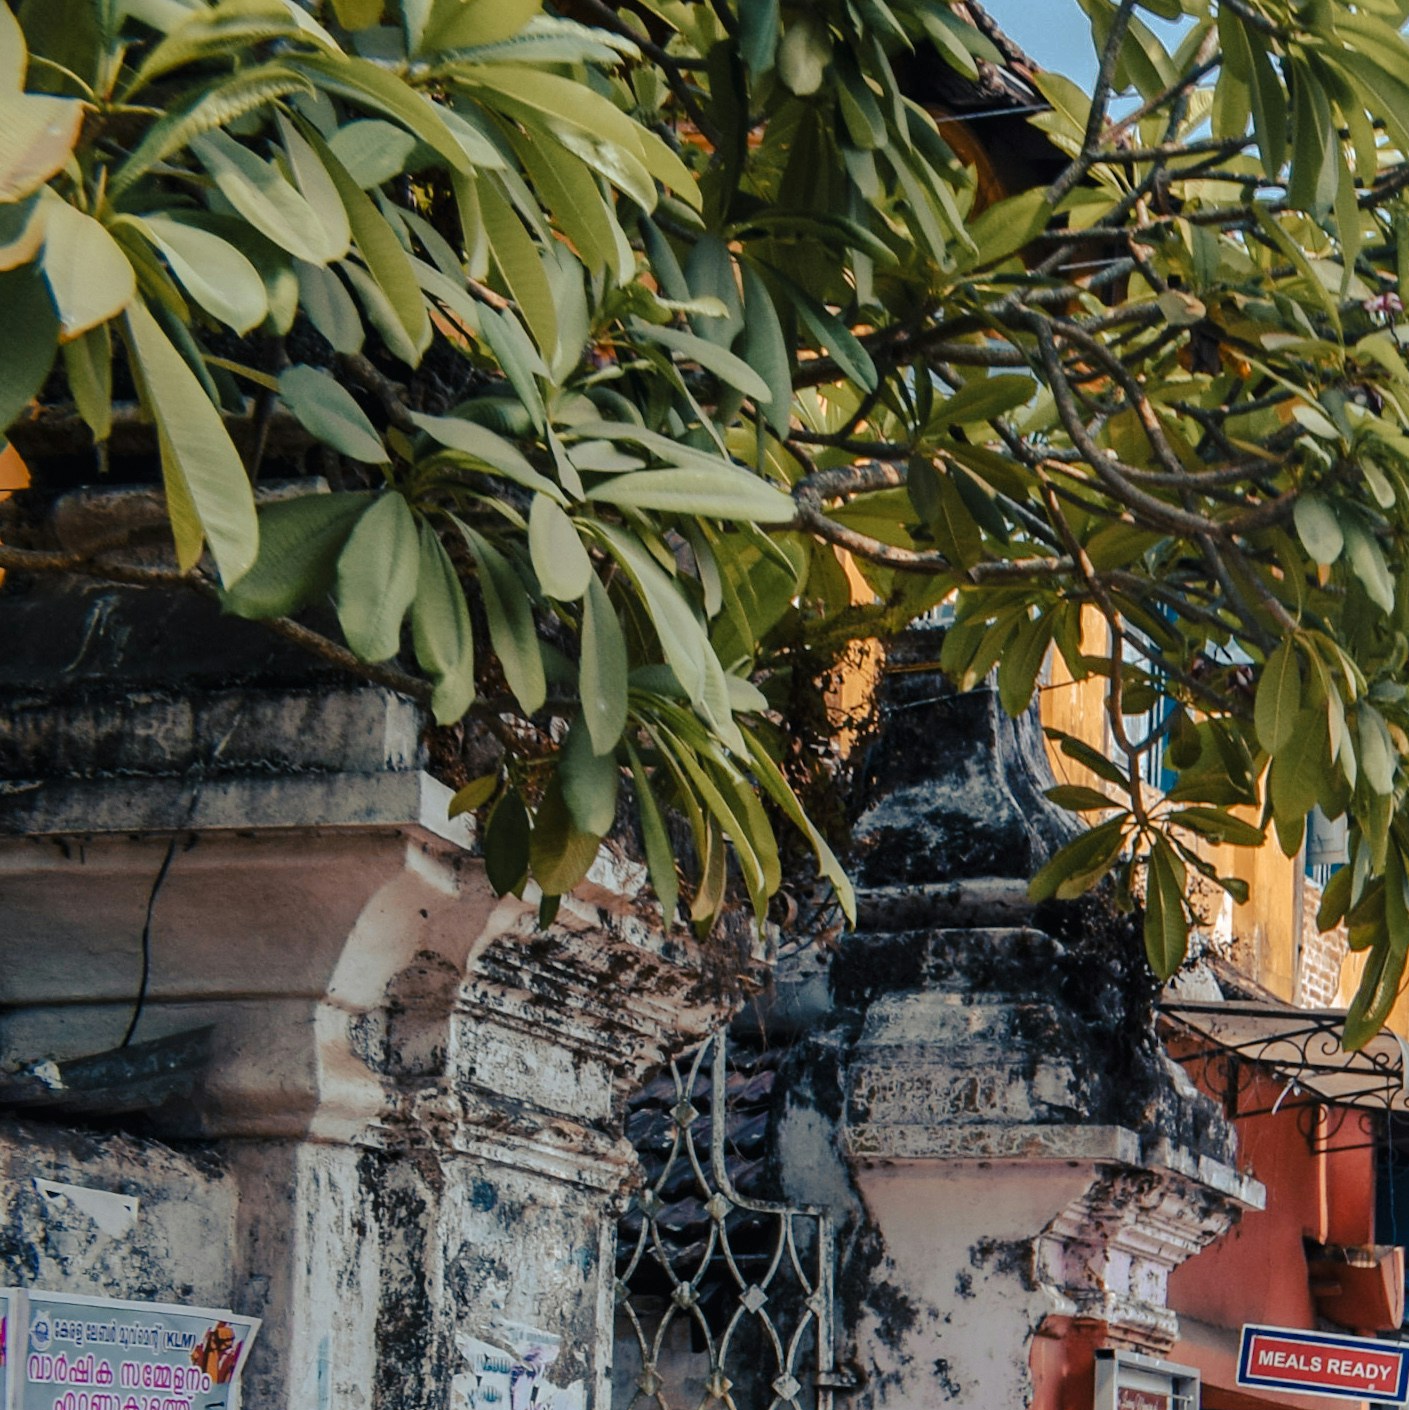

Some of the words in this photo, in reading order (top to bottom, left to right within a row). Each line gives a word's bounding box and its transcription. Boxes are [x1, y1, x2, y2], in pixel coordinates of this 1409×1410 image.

[29, 1353, 113, 1384] വാർഷിക
[120, 1361, 211, 1395] സമ്മേളനം
[1258, 1350, 1322, 1372] MEALS
[1327, 1359, 1392, 1381] READY
